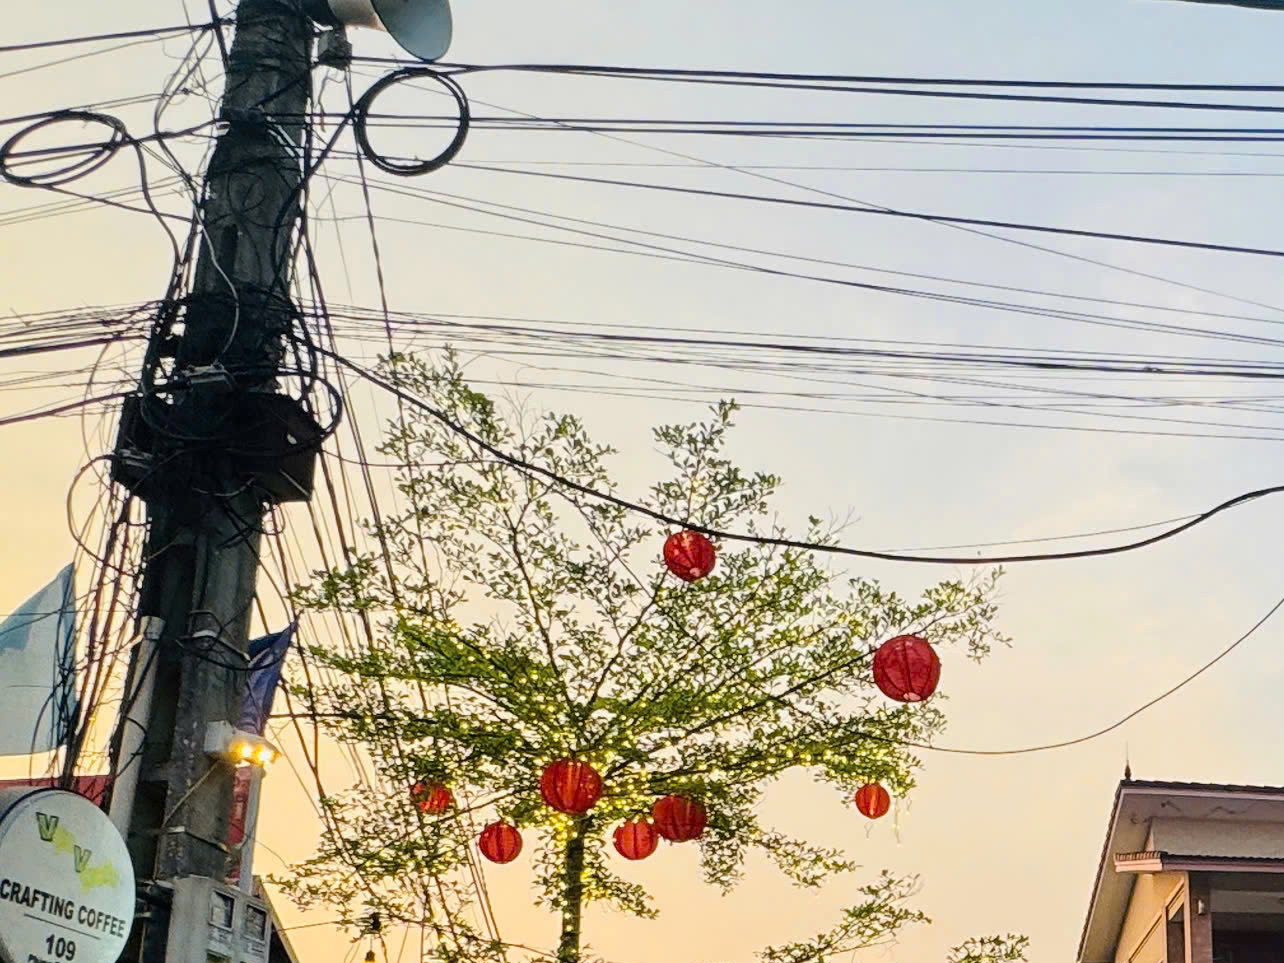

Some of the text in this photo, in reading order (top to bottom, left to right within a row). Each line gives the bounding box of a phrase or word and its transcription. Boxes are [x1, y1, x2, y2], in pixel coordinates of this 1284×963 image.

[0, 878, 127, 939] CRAFTING COFFEE
[46, 933, 77, 962] 109
